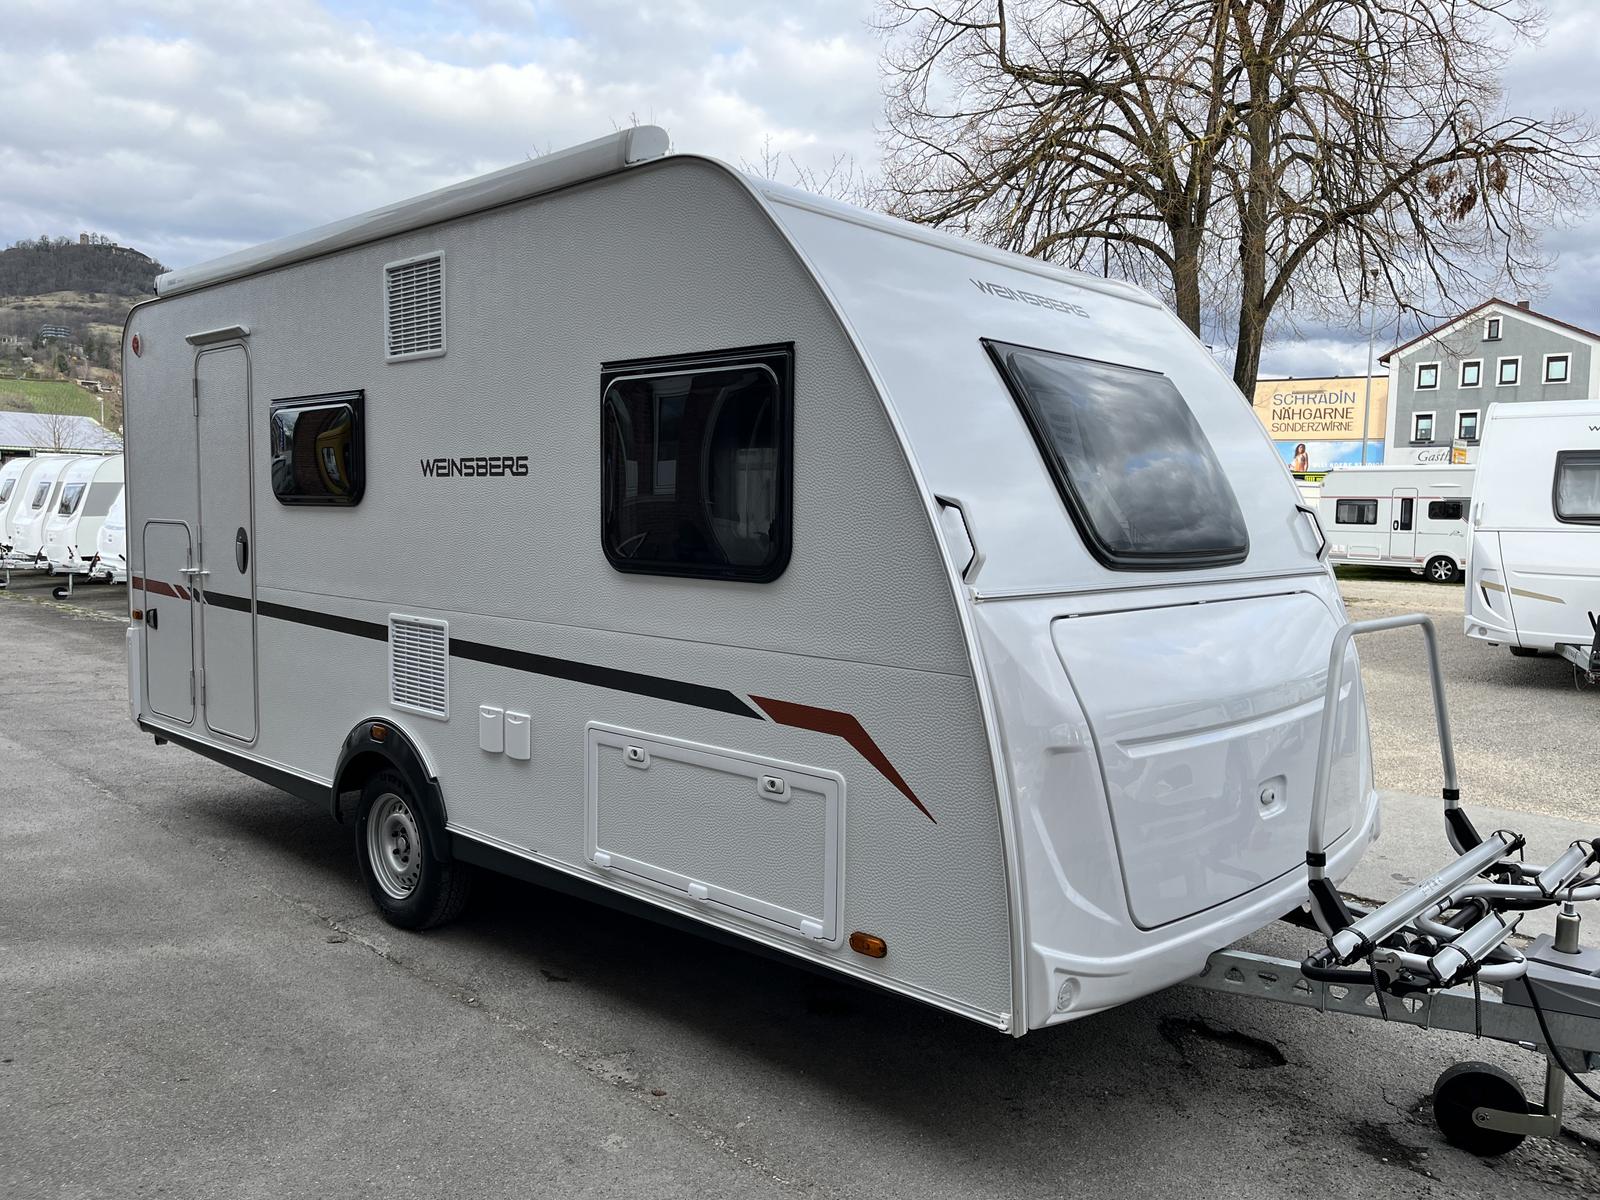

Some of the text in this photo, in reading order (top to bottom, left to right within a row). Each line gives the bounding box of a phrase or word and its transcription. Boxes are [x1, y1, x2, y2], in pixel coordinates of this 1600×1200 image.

[969, 278, 1090, 318] WEINSBERG
[1272, 407, 1354, 420] NÄHGARNE
[1271, 421, 1353, 432] SONDERZWIRNE
[420, 456, 529, 477] WEINSBERG
